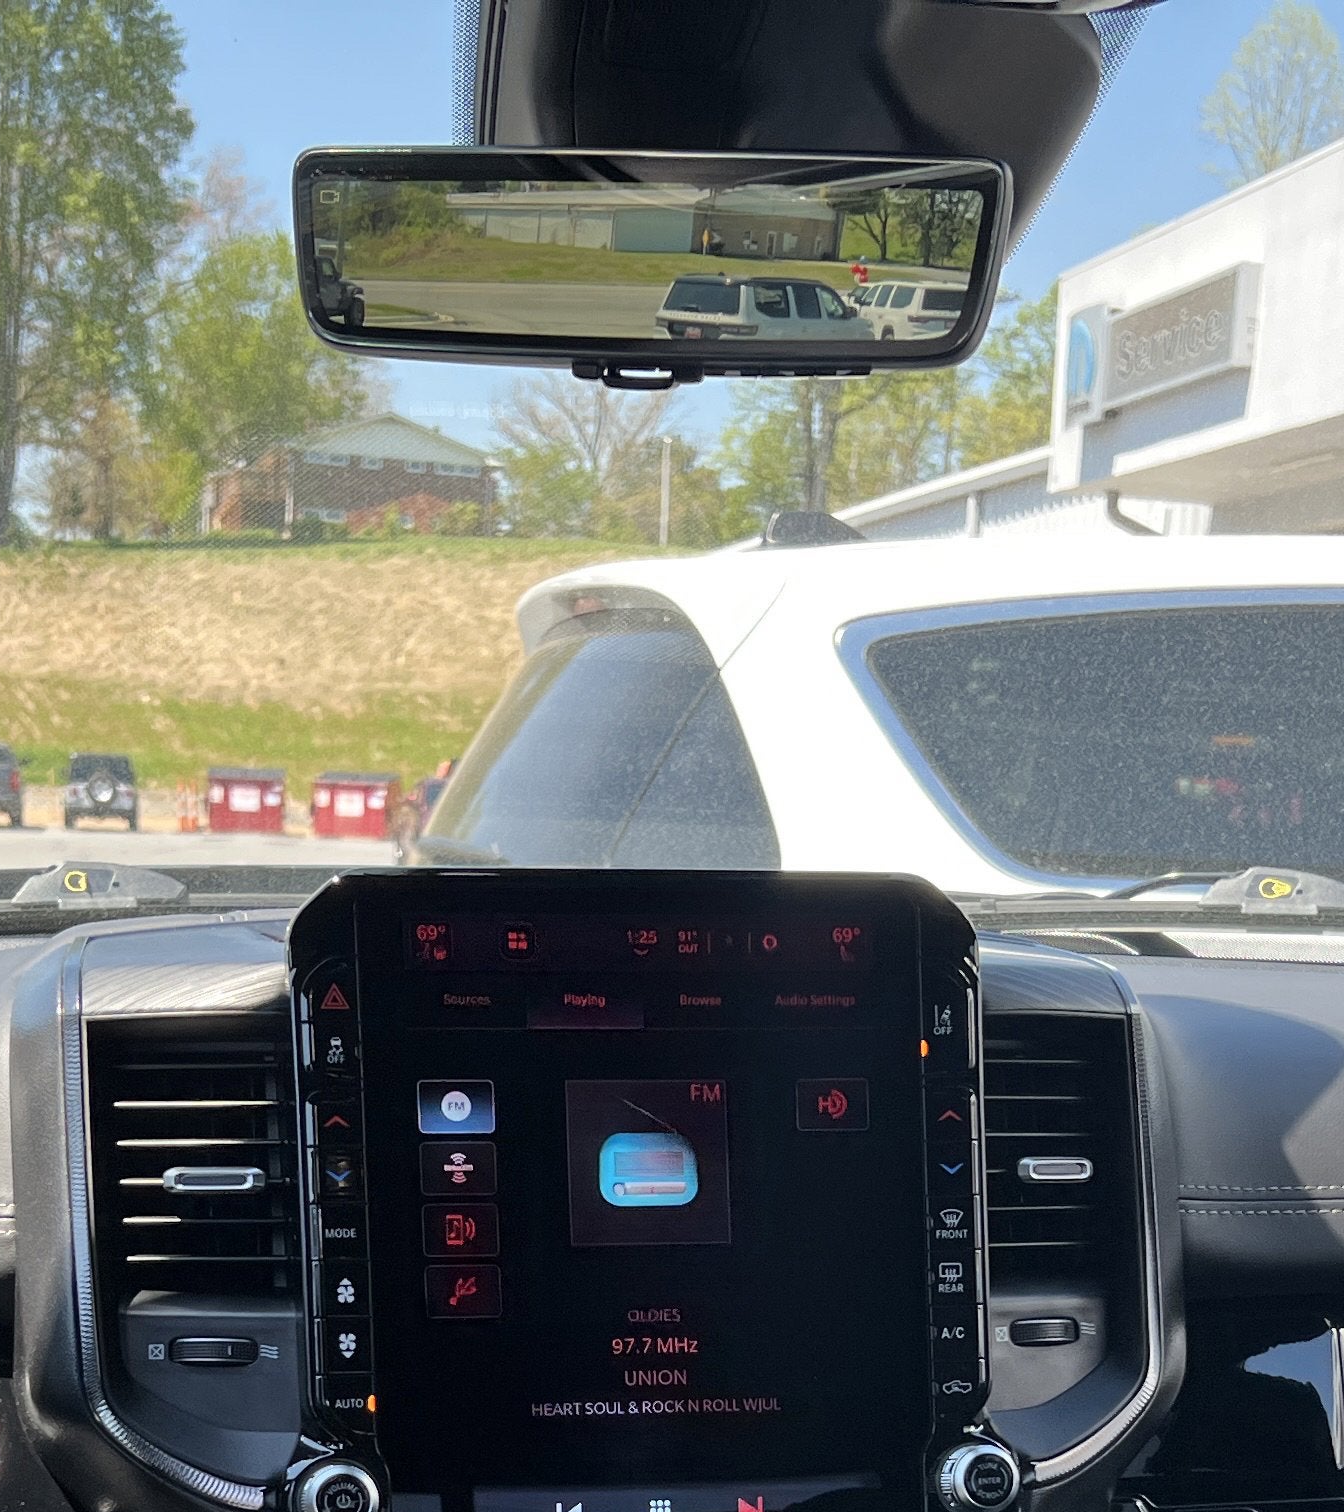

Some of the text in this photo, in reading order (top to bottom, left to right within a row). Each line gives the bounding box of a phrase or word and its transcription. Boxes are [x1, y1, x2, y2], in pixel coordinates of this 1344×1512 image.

[1116, 309, 1227, 381] Service
[832, 927, 861, 943] 69°
[678, 943, 699, 954] OUT
[443, 994, 491, 1006] Sources
[564, 993, 606, 1008] Playing
[680, 995, 722, 1006] Browse
[775, 995, 856, 1008] Audio Settings
[934, 1027, 953, 1035] OFF
[327, 1054, 345, 1064] OFF
[690, 1083, 721, 1101] FM
[447, 1101, 465, 1111] FM
[325, 1228, 357, 1239] MODE
[936, 1230, 968, 1239] FRONT
[938, 1283, 964, 1293] REAR
[627, 1308, 681, 1323] OLDIES
[941, 1327, 965, 1340] A/C
[611, 1337, 699, 1355] 97.7 MHz
[624, 1369, 688, 1387] UNION
[334, 1398, 364, 1409] AUTO
[531, 1398, 782, 1417] HEART SOUL & ROCK N ROLL WJUL
[978, 1476, 1001, 1485] ENTER
[327, 1482, 358, 1496] VOLUME
